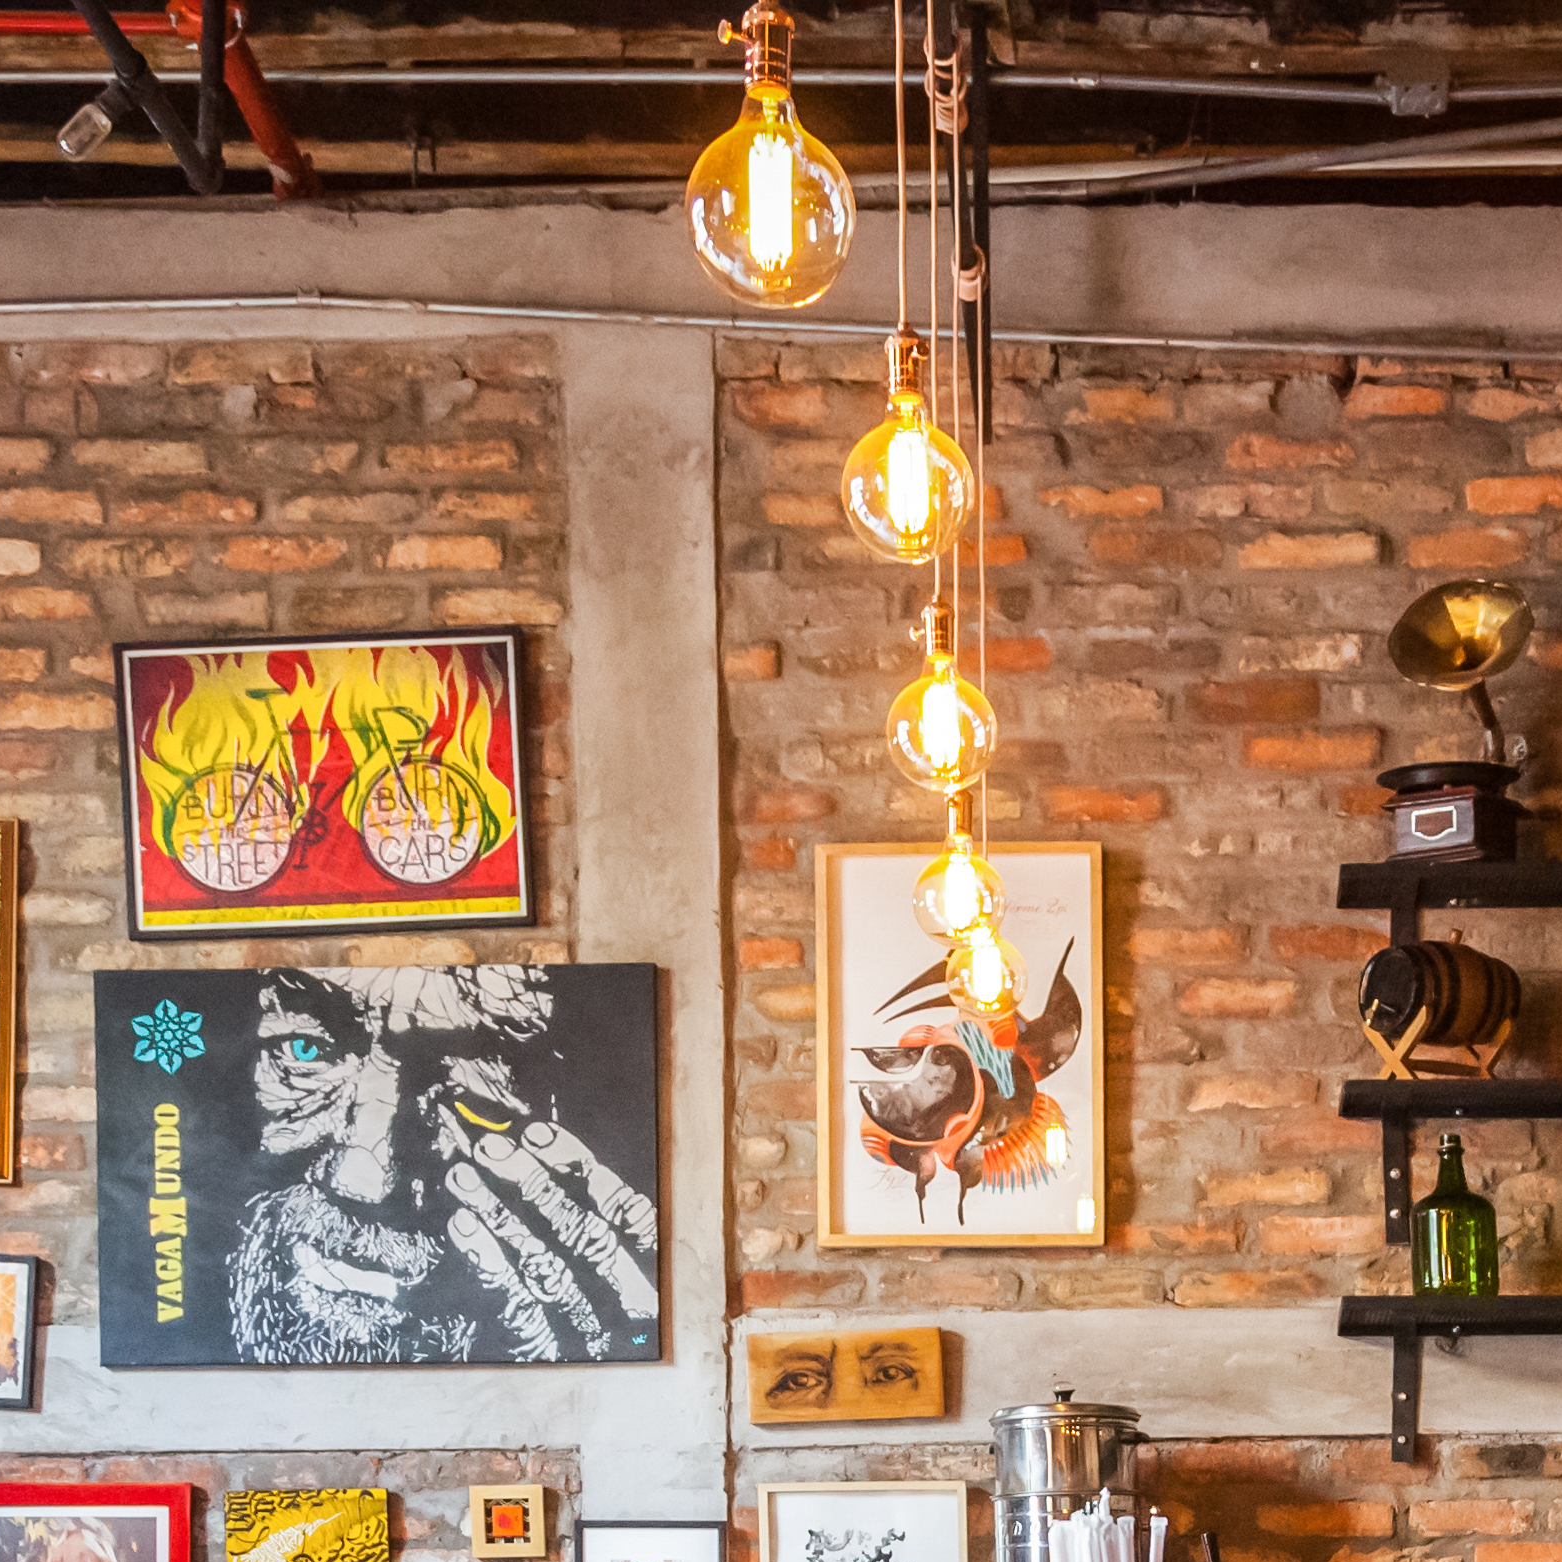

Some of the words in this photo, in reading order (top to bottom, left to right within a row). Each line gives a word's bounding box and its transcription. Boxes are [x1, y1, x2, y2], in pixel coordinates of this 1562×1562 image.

[183, 840, 289, 886] STREET
[379, 833, 468, 879] CARS
[149, 1103, 187, 1323] VAGAMUNDO
